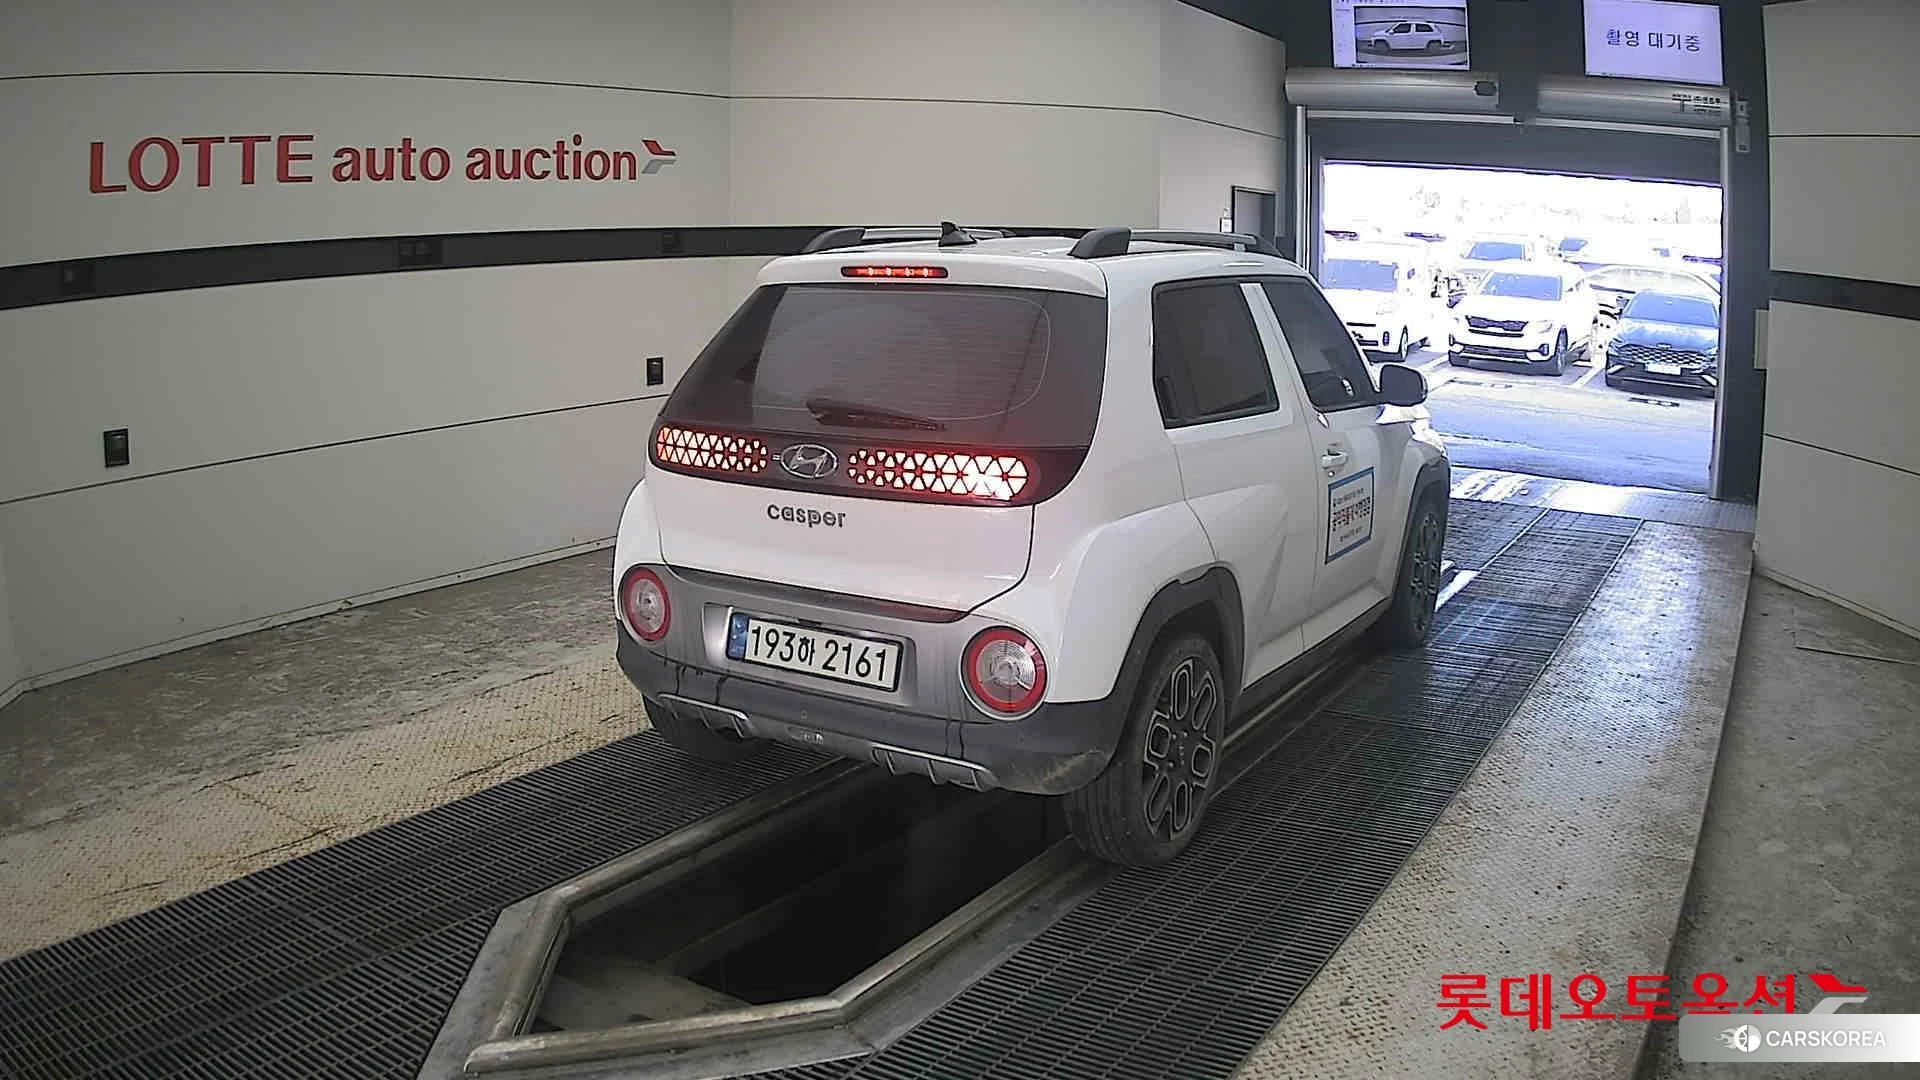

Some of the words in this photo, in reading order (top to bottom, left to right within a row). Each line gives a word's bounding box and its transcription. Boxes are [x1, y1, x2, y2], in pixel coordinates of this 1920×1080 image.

[1648, 32, 1701, 52] 대기중
[89, 134, 315, 193] LOTTE
[332, 138, 451, 182] auto
[465, 133, 638, 182] auction
[767, 504, 846, 528] casper
[751, 625, 815, 666] 193하
[822, 639, 887, 681] 2161
